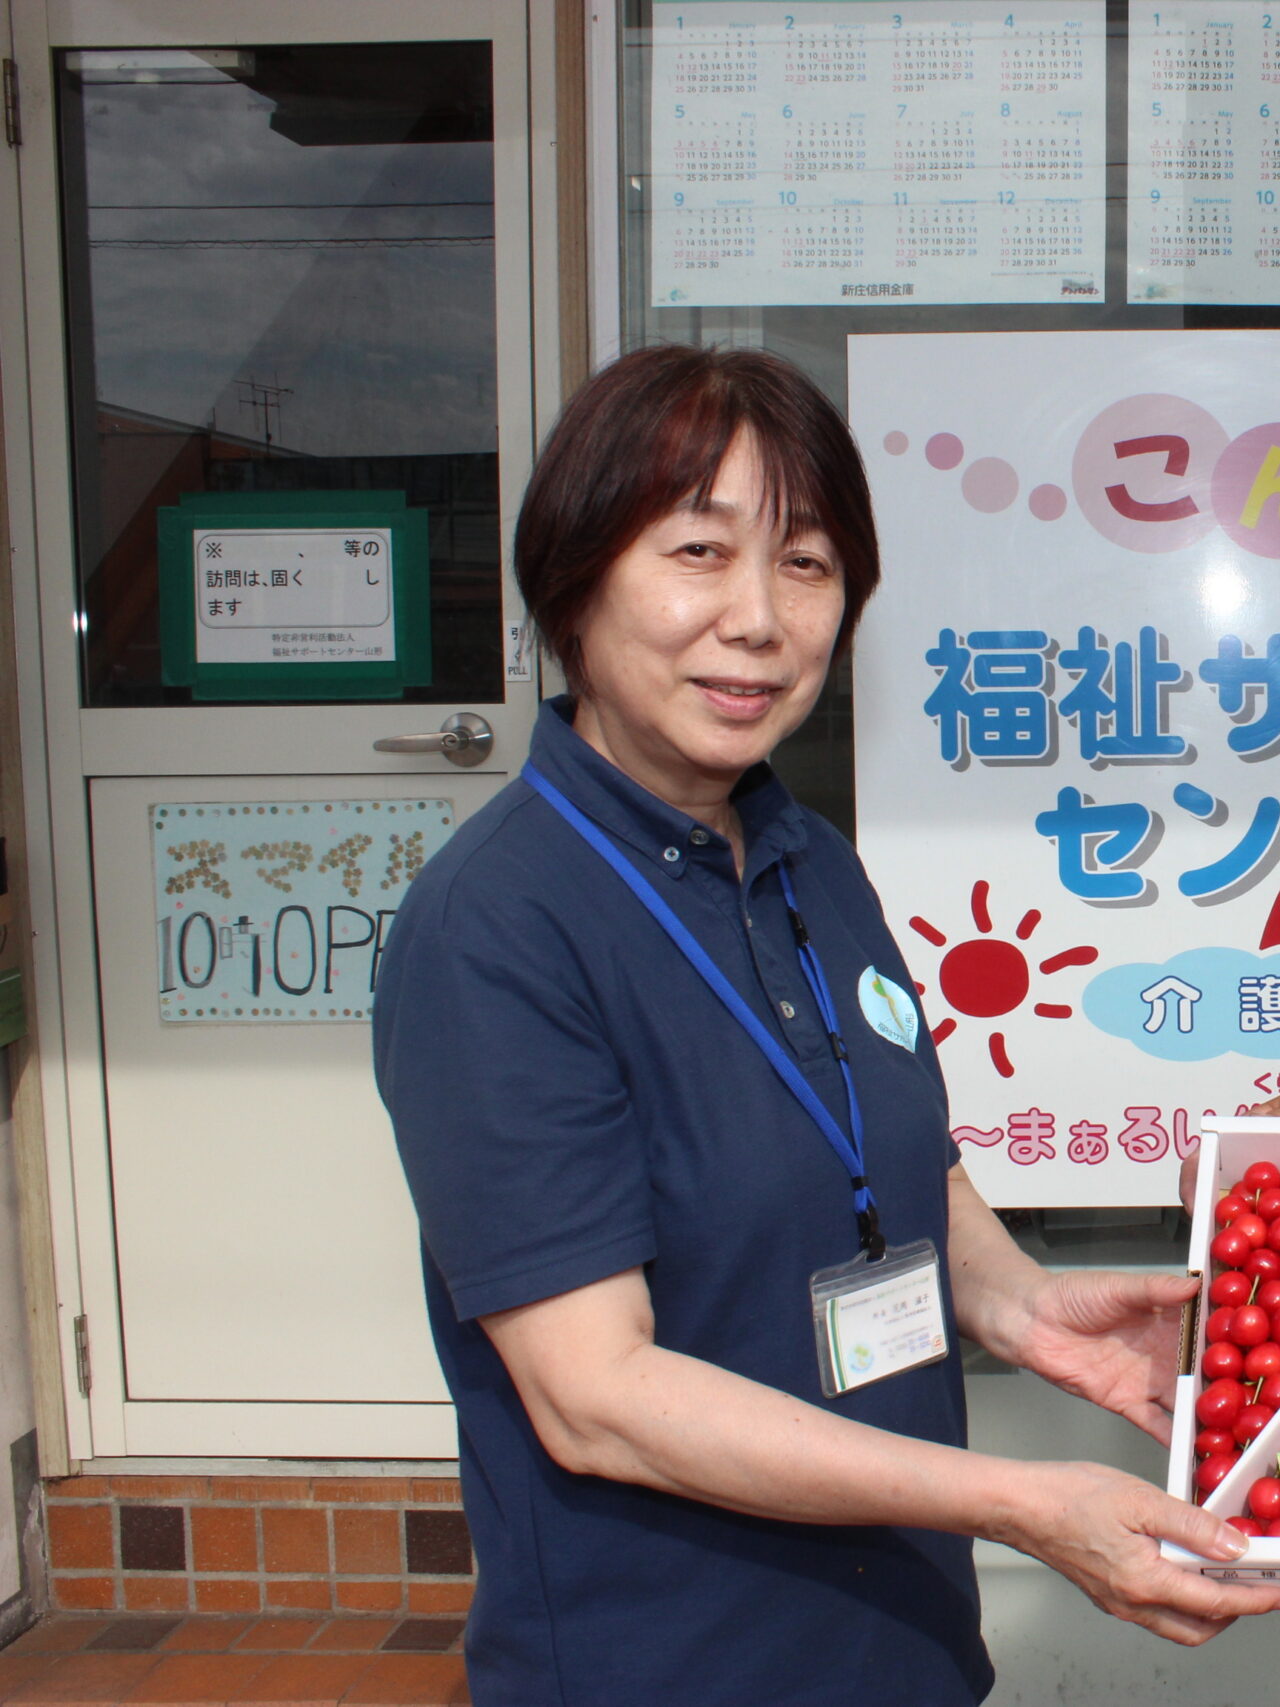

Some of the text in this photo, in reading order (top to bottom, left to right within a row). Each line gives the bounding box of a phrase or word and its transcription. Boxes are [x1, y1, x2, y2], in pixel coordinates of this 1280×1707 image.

[677, 16, 683, 29] 1
[785, 15, 794, 29] 2
[893, 14, 902, 28] 3
[1004, 14, 1014, 27] 4
[1153, 13, 1160, 26] 1
[1263, 14, 1272, 28] 2
[675, 104, 685, 118] 5
[782, 104, 793, 119] 6
[897, 104, 907, 118] 7
[1001, 102, 1011, 117] 8
[1152, 102, 1162, 116] 5
[1260, 104, 1270, 117] 6
[674, 192, 684, 206] 9
[779, 190, 797, 205] 10
[893, 192, 909, 205] 11
[998, 190, 1015, 205] 12
[1150, 189, 1232, 205] 9 September
[1256, 190, 1275, 204] 10
[841, 283, 915, 297] 新庄信用金庫
[343, 539, 380, 558] 等の
[206, 569, 380, 588] 訪問は、固く し
[208, 599, 242, 617] ます
